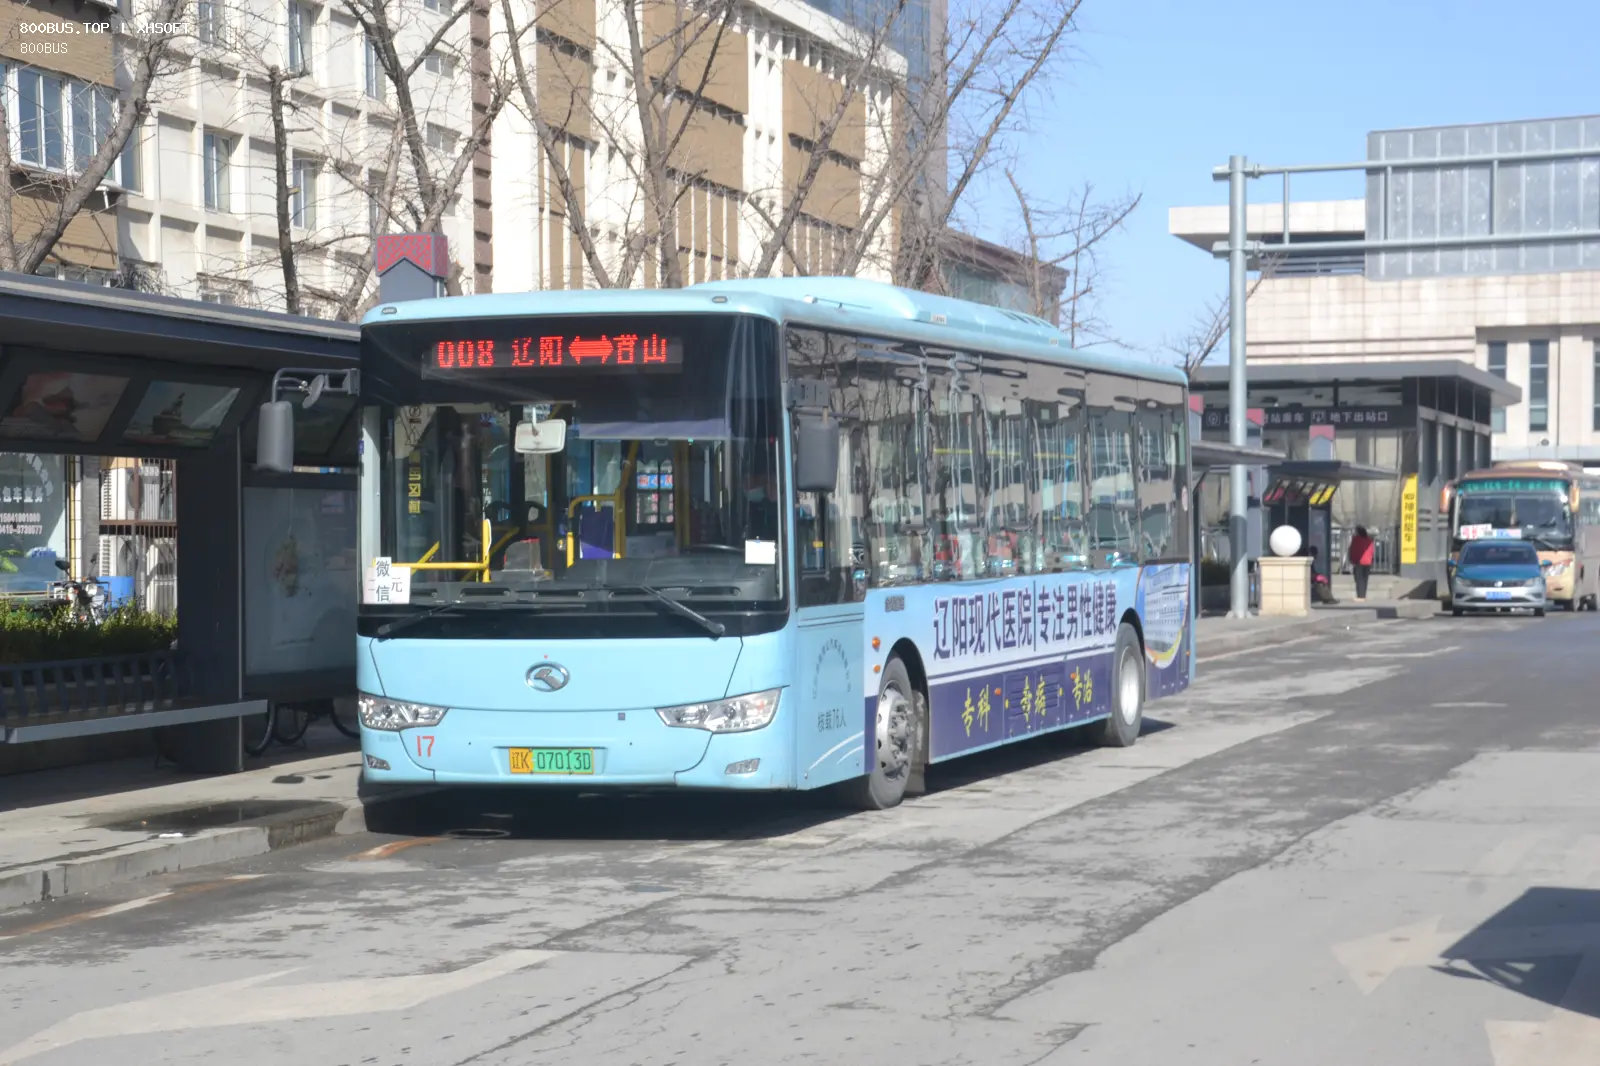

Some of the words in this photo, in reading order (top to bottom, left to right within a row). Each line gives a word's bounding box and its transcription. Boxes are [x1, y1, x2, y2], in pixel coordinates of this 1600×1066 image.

[437, 341, 495, 368] 008
[0, 485, 44, 503] 包车业务
[376, 560, 391, 602] 微信
[416, 735, 435, 758] 17
